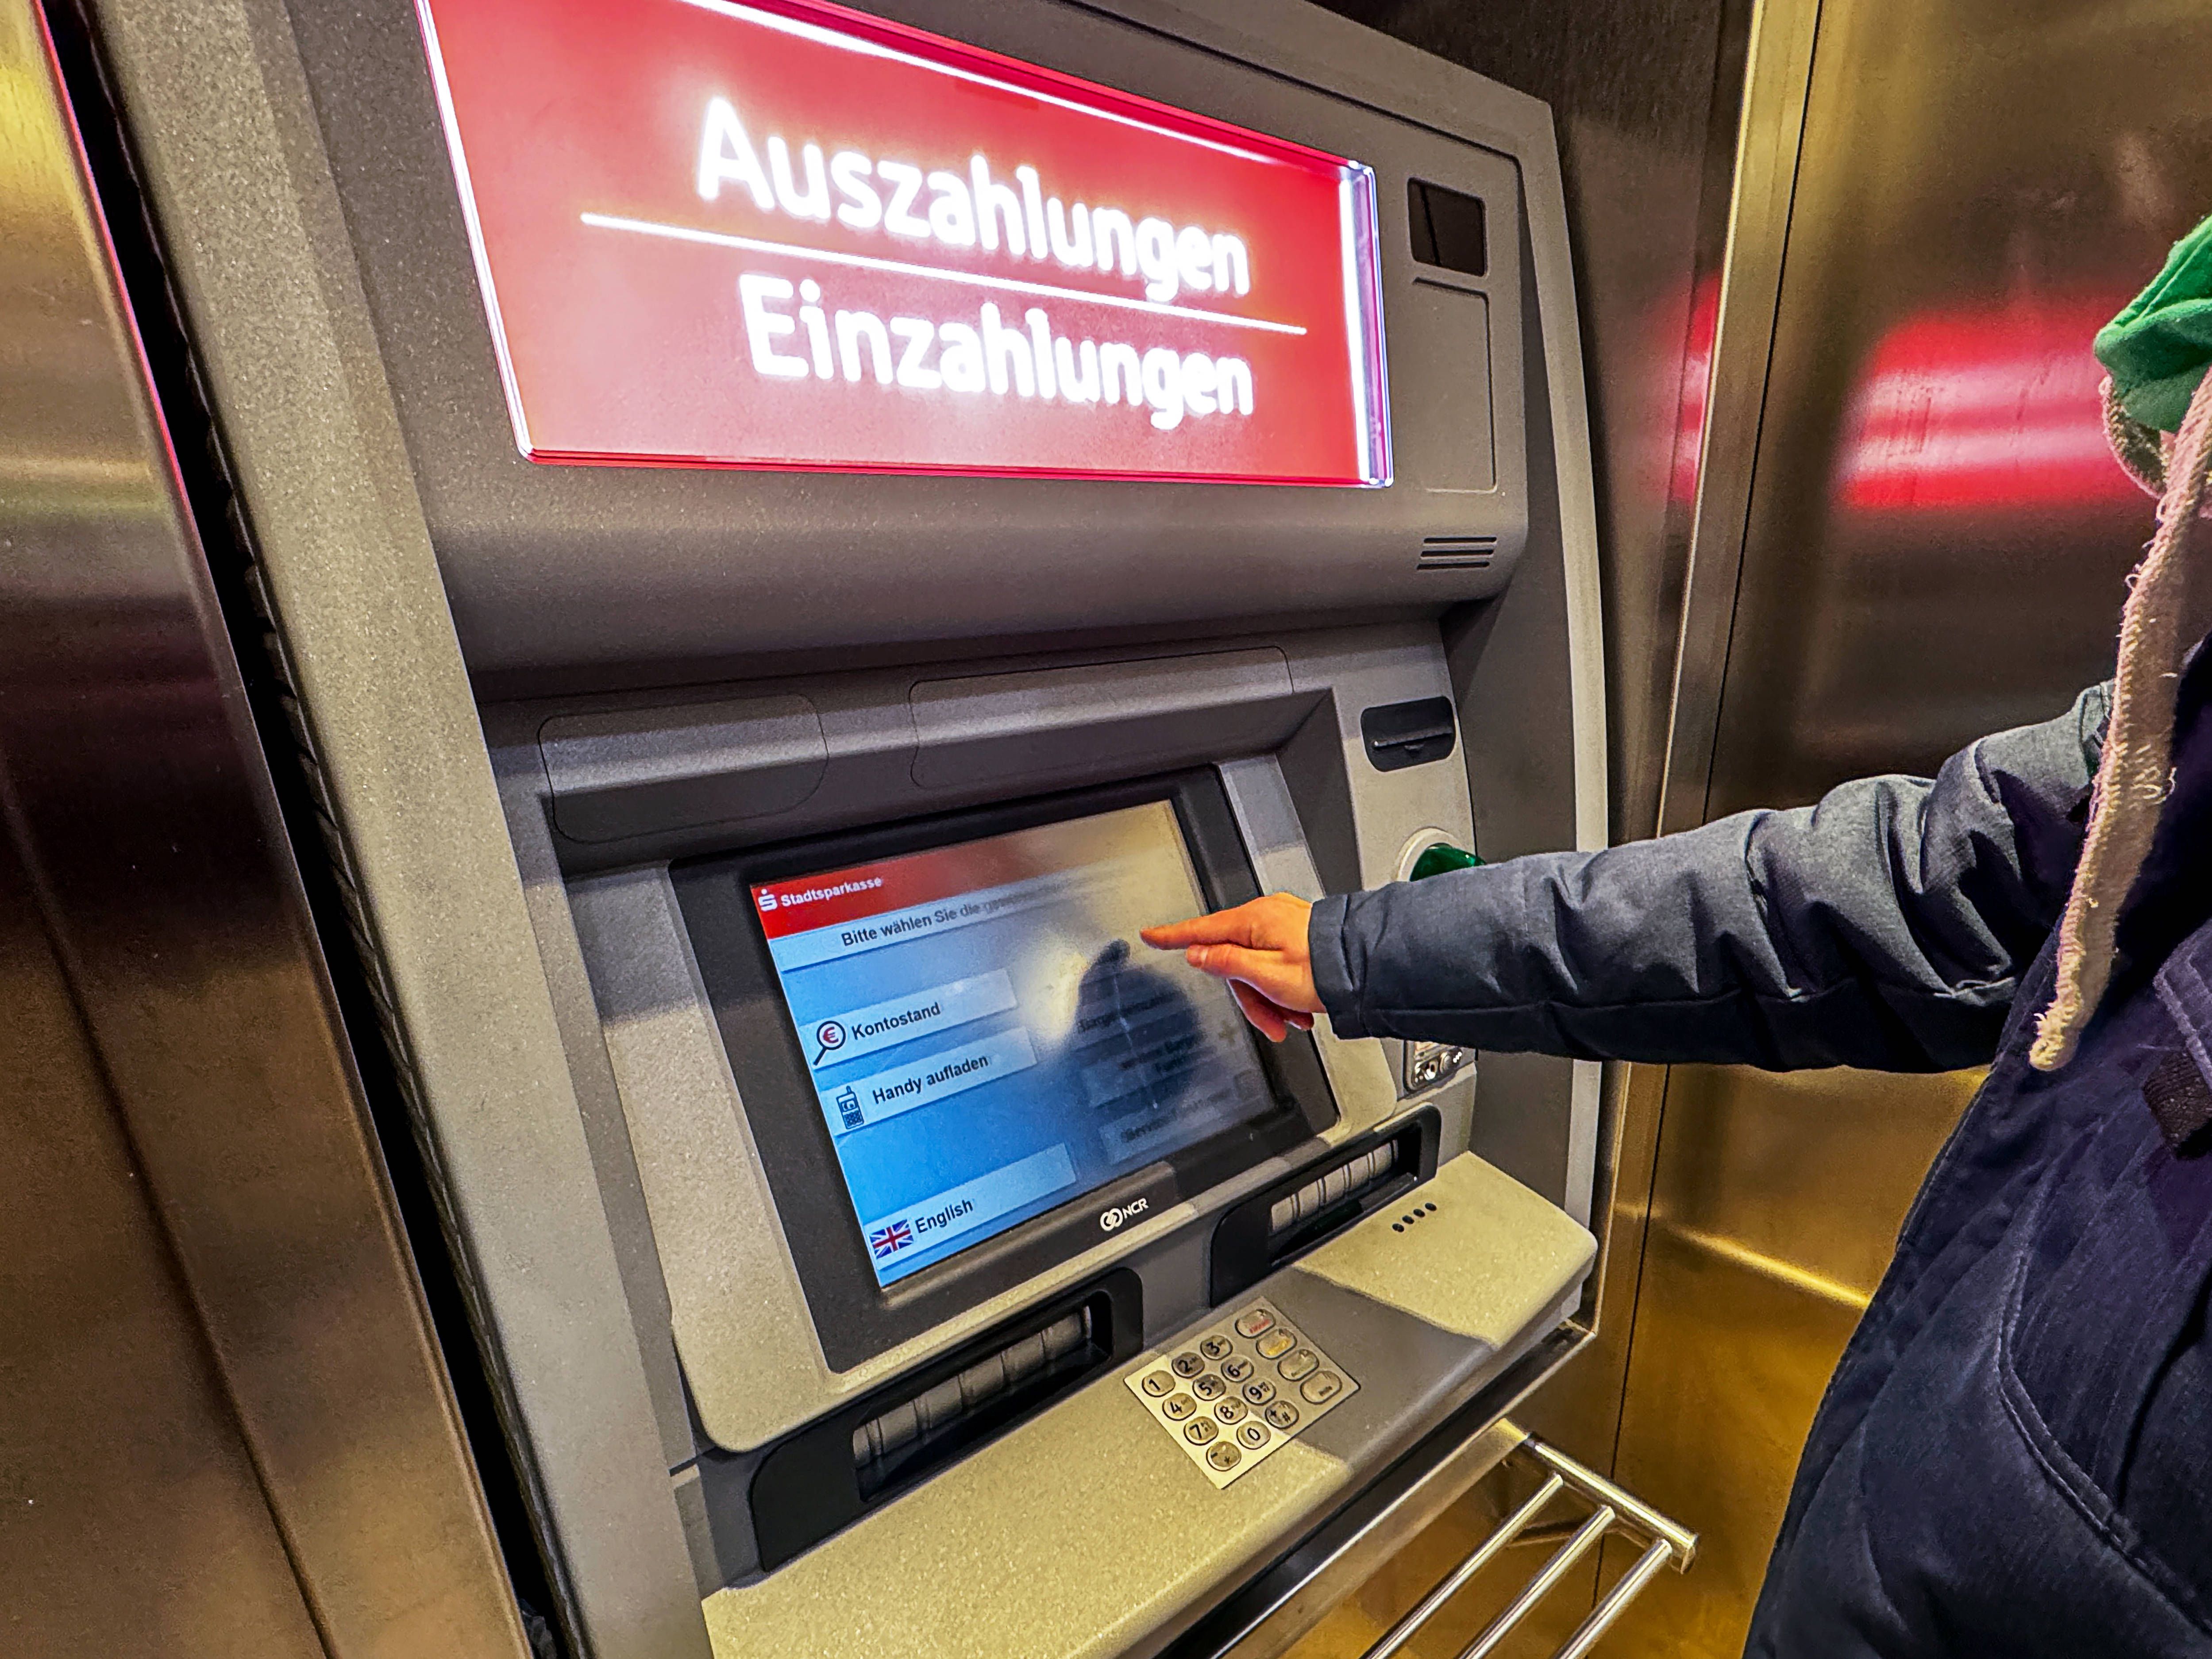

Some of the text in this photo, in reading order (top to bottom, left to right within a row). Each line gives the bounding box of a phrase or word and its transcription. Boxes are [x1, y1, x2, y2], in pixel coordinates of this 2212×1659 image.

[697, 98, 1250, 299] Auszahlungen
[740, 273, 1253, 429] Einzahlungen
[781, 877, 882, 907] Stadtsparkasse
[841, 928, 878, 946] Bitte
[881, 916, 932, 936] wählen
[935, 907, 957, 923] Sie
[852, 1002, 941, 1039] Kontostand
[873, 1056, 989, 1104] Handy aufladen
[1122, 1198, 1149, 1219] NCR
[916, 1200, 973, 1233] English
[1206, 1342, 1220, 1355] 3
[1178, 1359, 1193, 1373] 2
[1227, 1364, 1241, 1377] 6
[1148, 1378, 1160, 1390] 1
[1198, 1382, 1212, 1396] 5
[1249, 1386, 1262, 1400] 9
[1170, 1401, 1182, 1414] 4
[1220, 1405, 1233, 1419] 8
[1189, 1424, 1202, 1439] 7
[1247, 1428, 1261, 1441] 0
